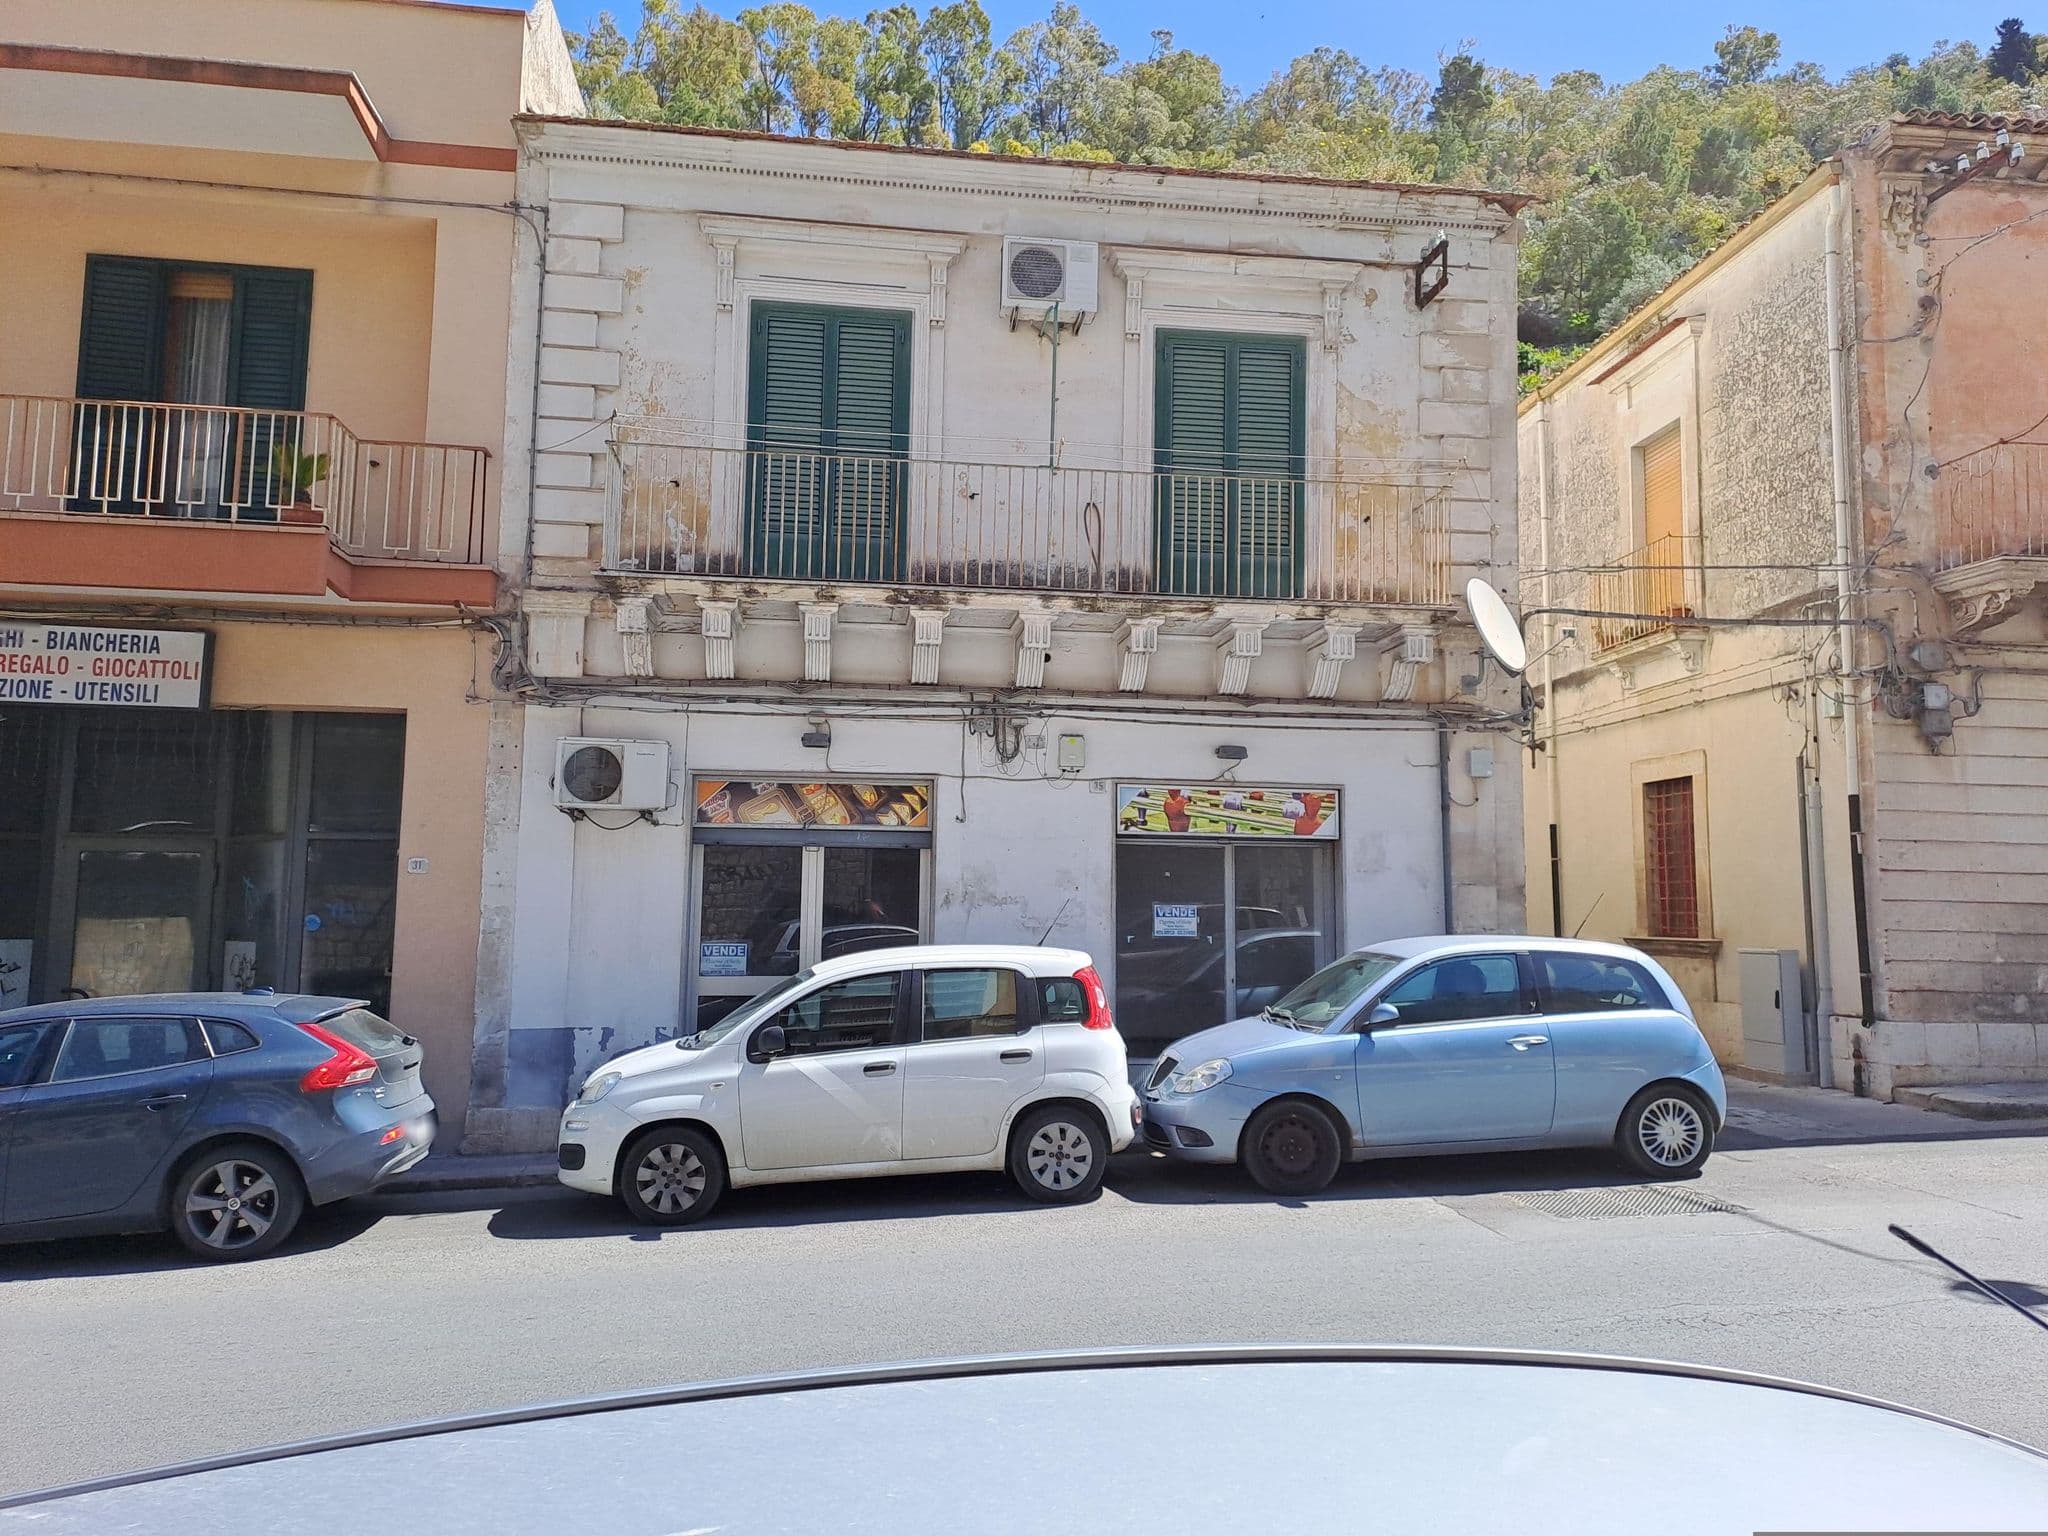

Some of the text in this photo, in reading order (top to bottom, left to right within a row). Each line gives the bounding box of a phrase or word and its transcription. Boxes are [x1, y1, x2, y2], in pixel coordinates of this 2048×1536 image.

[0, 629, 23, 648] HI
[47, 630, 160, 654] BIANCHERIA
[92, 657, 199, 681] GIOCATTOLI
[75, 681, 159, 703] UTENSILI
[1157, 907, 1195, 917] VENDE
[703, 946, 745, 956] VENDE
